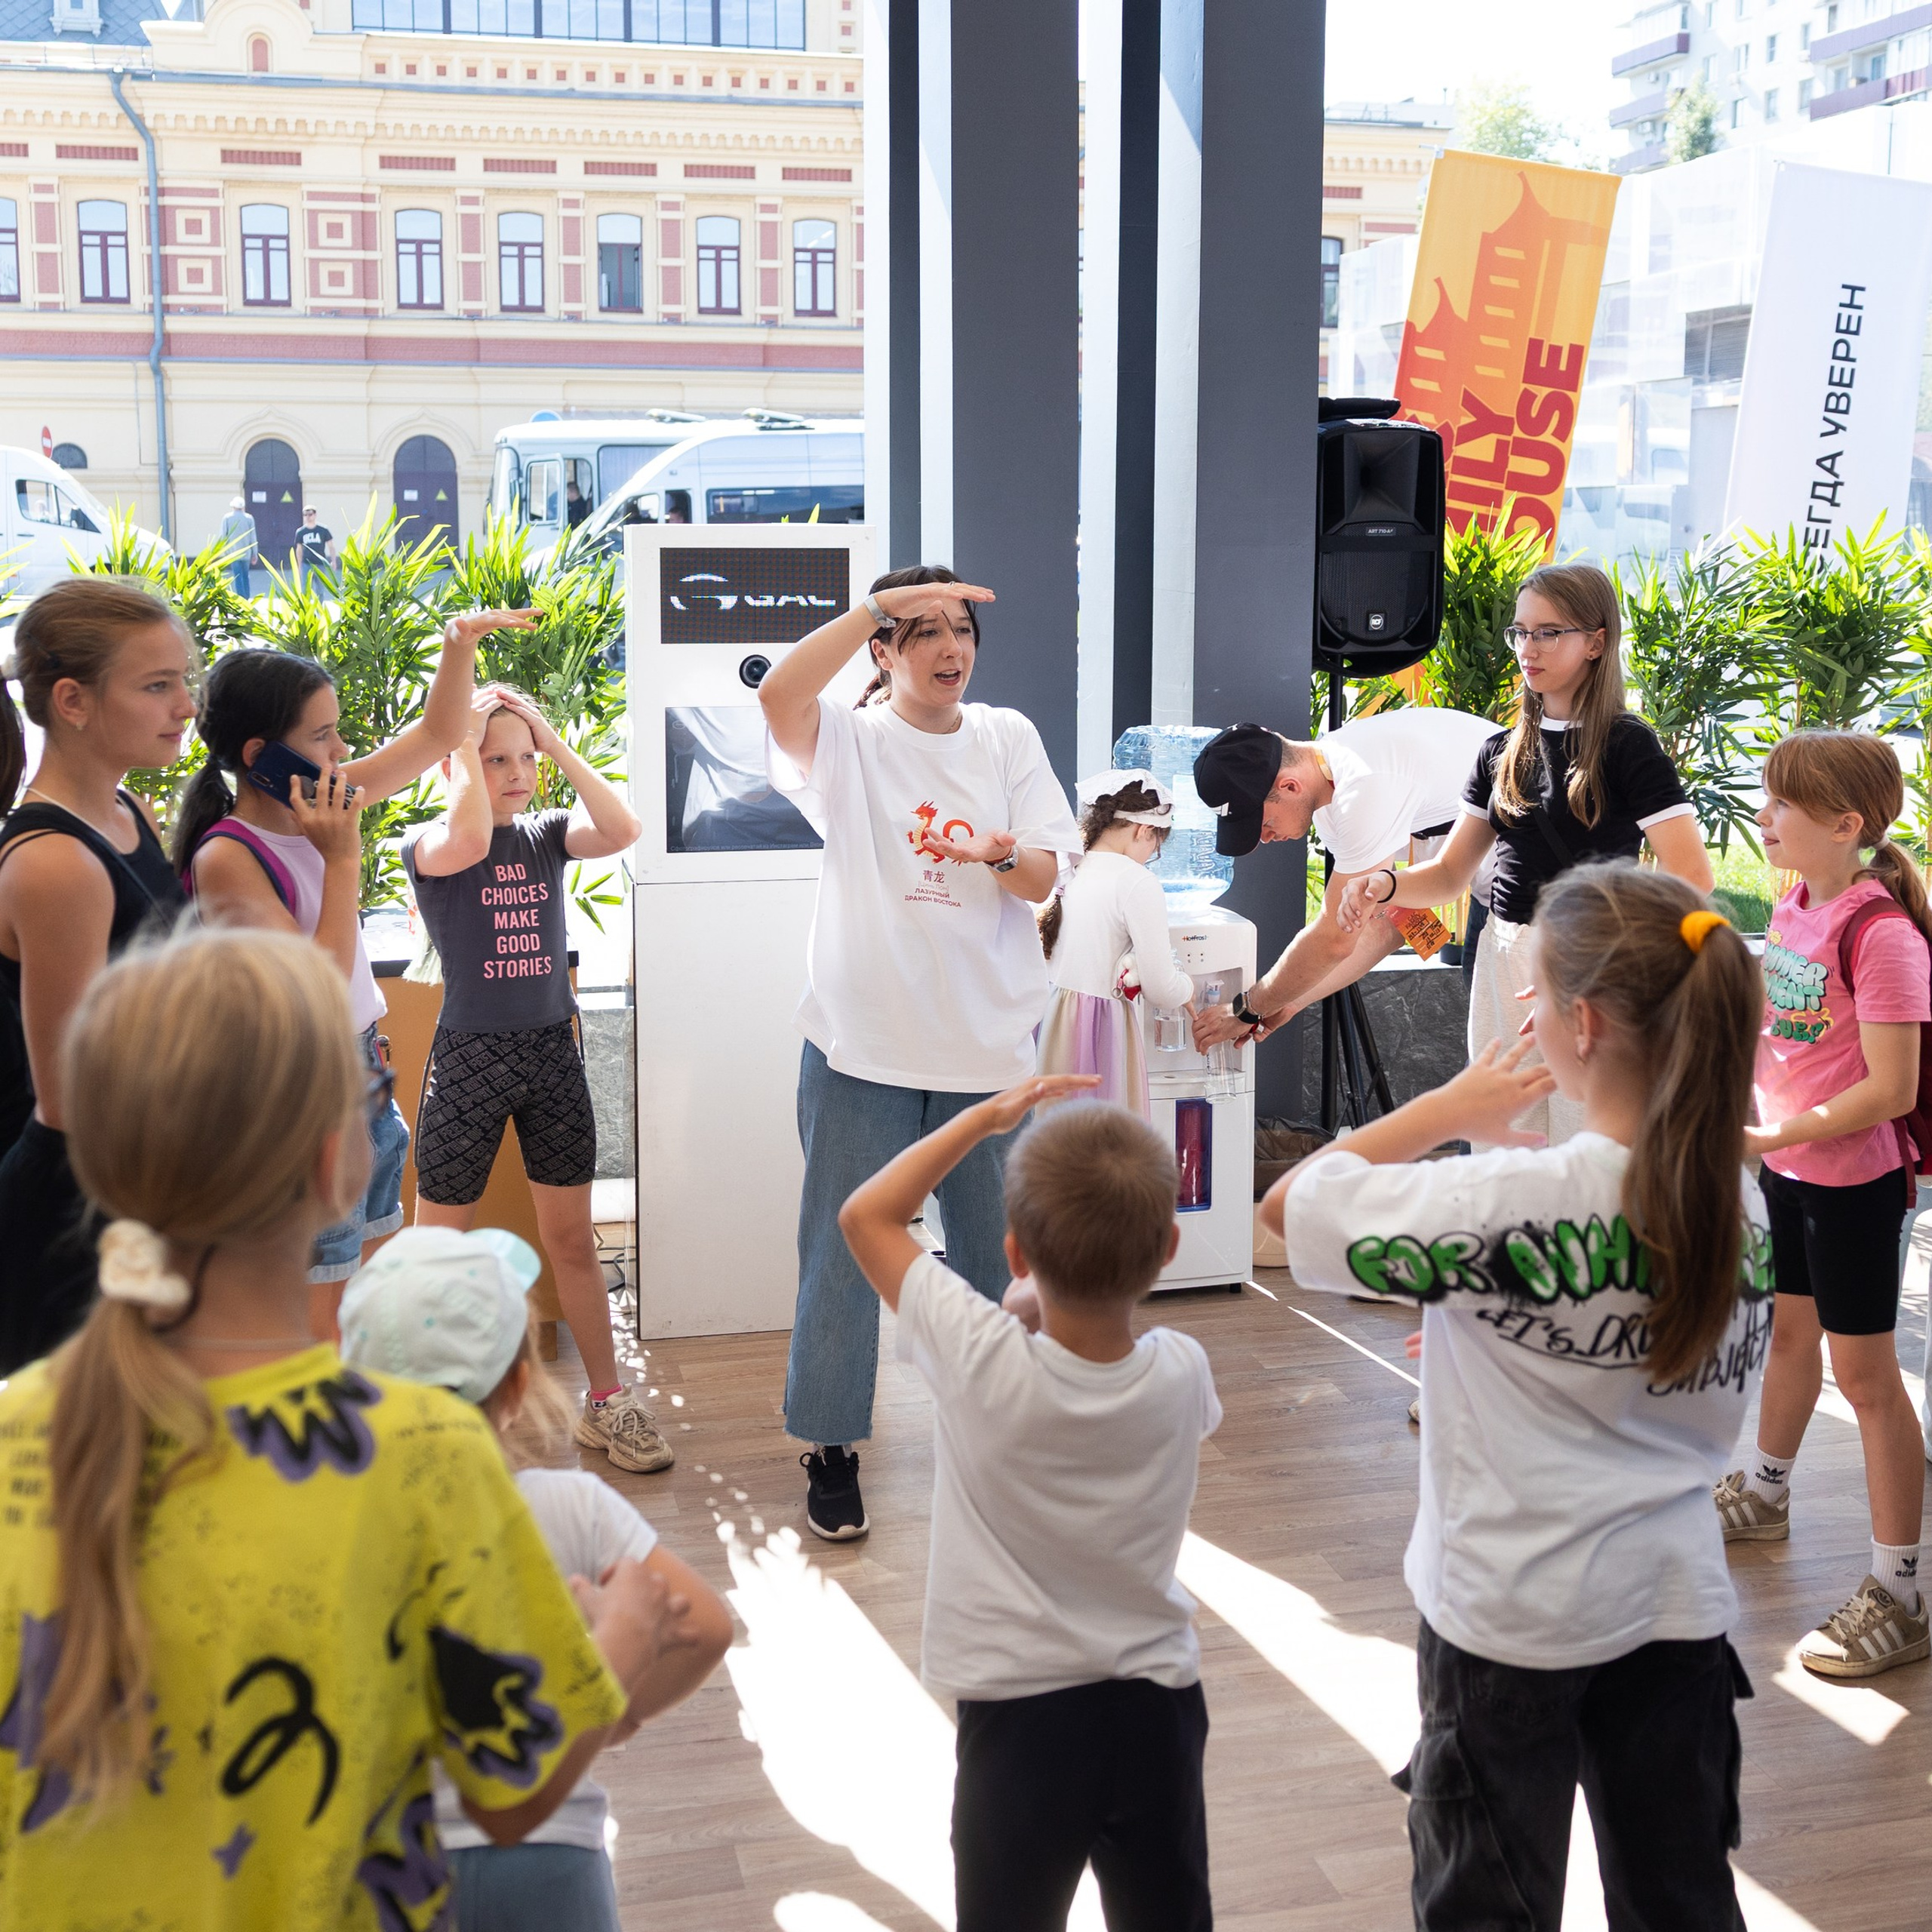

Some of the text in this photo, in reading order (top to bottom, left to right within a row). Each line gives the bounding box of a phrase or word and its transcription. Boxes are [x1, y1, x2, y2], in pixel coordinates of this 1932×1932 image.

[1803, 284, 1866, 575] ЕГДА УВЕРЕН
[303, 532, 321, 543] UCLA
[495, 863, 527, 882] BAD
[923, 869, 945, 883] 青龙
[481, 882, 549, 906] CHOICES
[915, 888, 949, 899] ЛАЗУРНЫЙ
[934, 897, 961, 907] ВОСТОКА
[494, 909, 540, 930] MAKE
[497, 933, 540, 955] GOOD
[483, 956, 552, 979] STORIES
[467, 1051, 499, 1072] FEEL
[439, 1084, 466, 1103] THE
[460, 1061, 510, 1093] RHYTHM
[503, 1051, 521, 1067] OF
[441, 1103, 460, 1120] OF
[455, 1084, 497, 1112] SPORT
[490, 1072, 522, 1093] FEEL
[438, 1120, 470, 1142] FEEL
[461, 1106, 489, 1126] THE
[549, 1130, 582, 1151] FEEL
[1346, 1231, 1497, 1296] FOR
[1755, 1472, 1783, 1484] adidas
